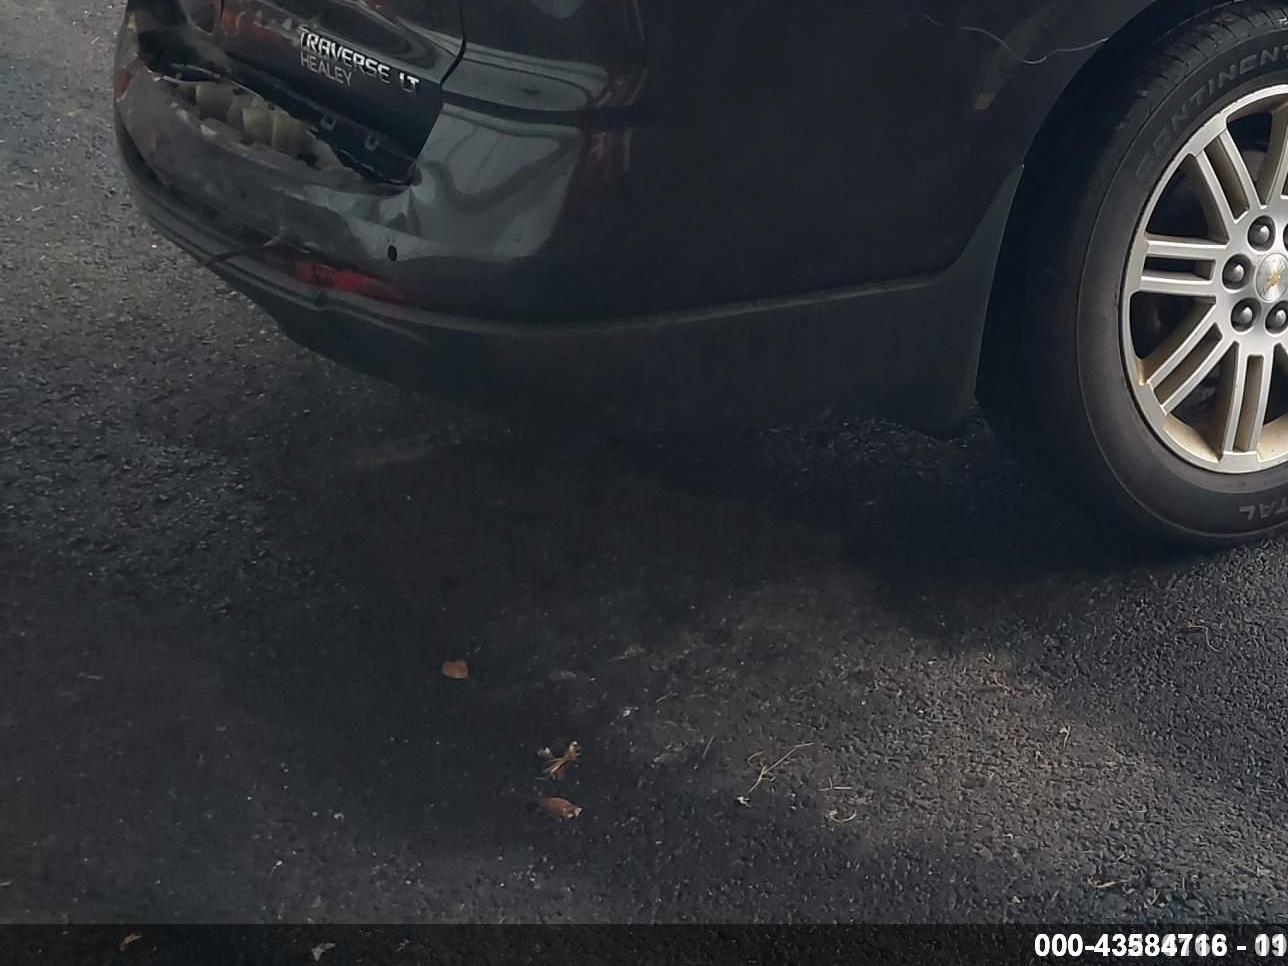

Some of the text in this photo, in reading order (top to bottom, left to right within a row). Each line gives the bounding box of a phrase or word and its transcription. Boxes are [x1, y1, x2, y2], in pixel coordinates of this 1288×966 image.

[300, 27, 420, 94] TRAVERSE LT
[300, 50, 352, 87] HEALEY
